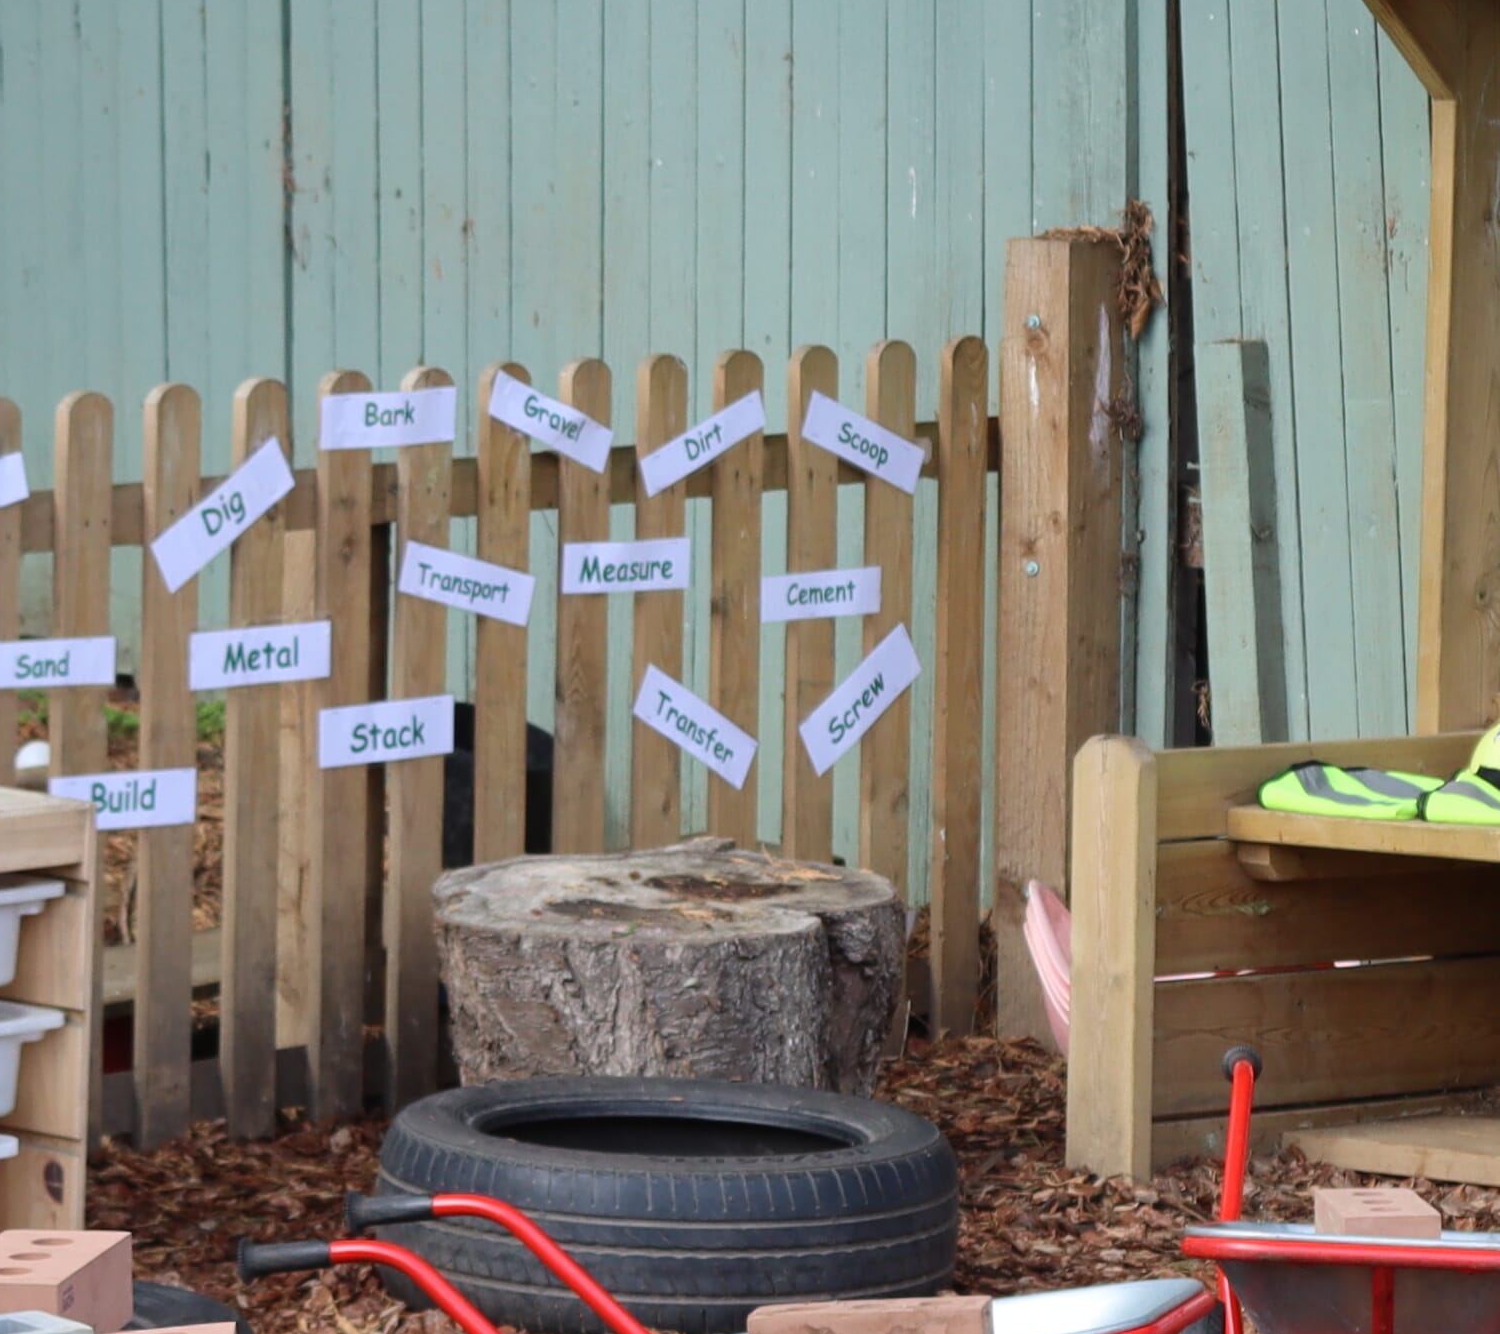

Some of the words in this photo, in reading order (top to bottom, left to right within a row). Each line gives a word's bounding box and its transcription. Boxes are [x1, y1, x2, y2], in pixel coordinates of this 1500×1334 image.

[364, 401, 414, 427] Bark
[524, 395, 585, 441] Gravel
[684, 424, 722, 460] Dirt
[837, 422, 889, 467] Scoop
[201, 489, 247, 537] Dig
[418, 563, 510, 603] Transport
[580, 557, 672, 582] Measure
[787, 581, 855, 605] Cement
[15, 652, 69, 679] Sand
[223, 636, 299, 673] Metal
[828, 673, 885, 743] Screw
[351, 716, 425, 753] Stack
[656, 691, 735, 765] Transfer
[91, 779, 156, 813] Build
